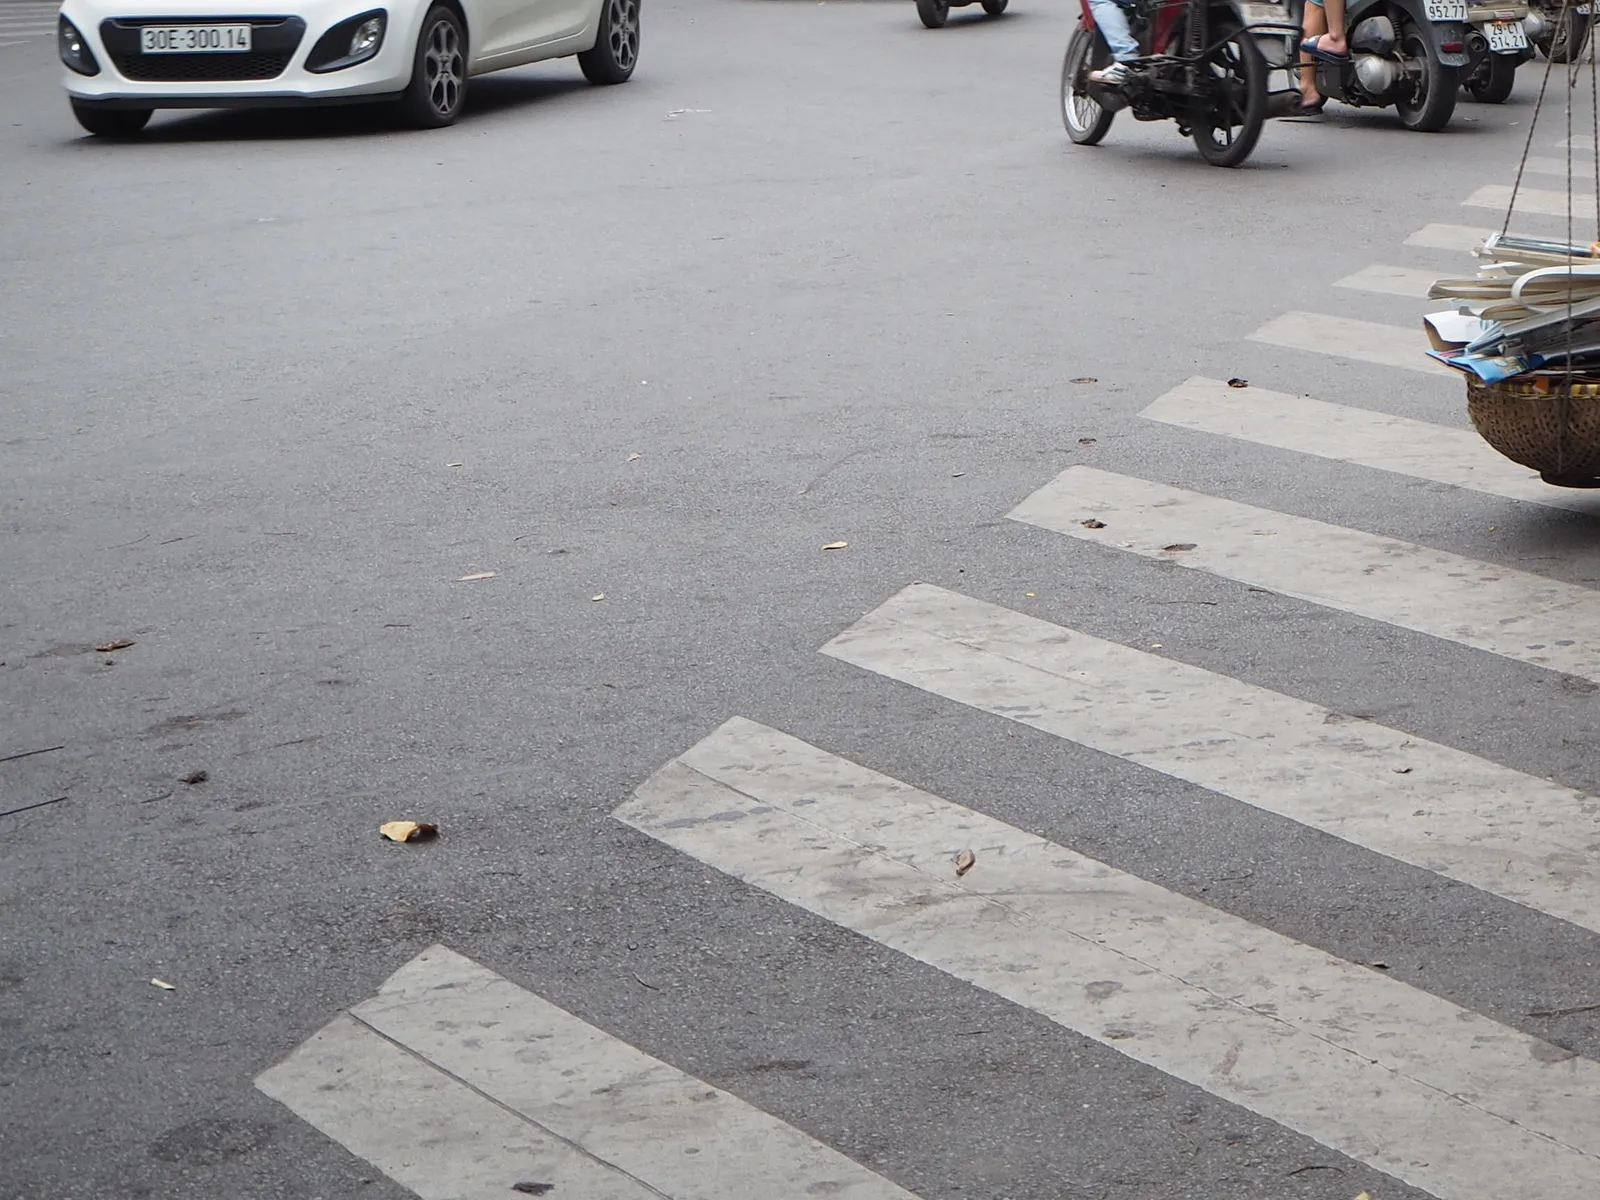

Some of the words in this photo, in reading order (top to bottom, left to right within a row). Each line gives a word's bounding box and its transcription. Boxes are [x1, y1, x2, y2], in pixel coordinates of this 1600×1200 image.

[1429, 4, 1465, 20] 952.77
[1491, 22, 1520, 37] 29-C1
[144, 29, 248, 50] 30E-300.14
[1490, 35, 1527, 49] 514.21
